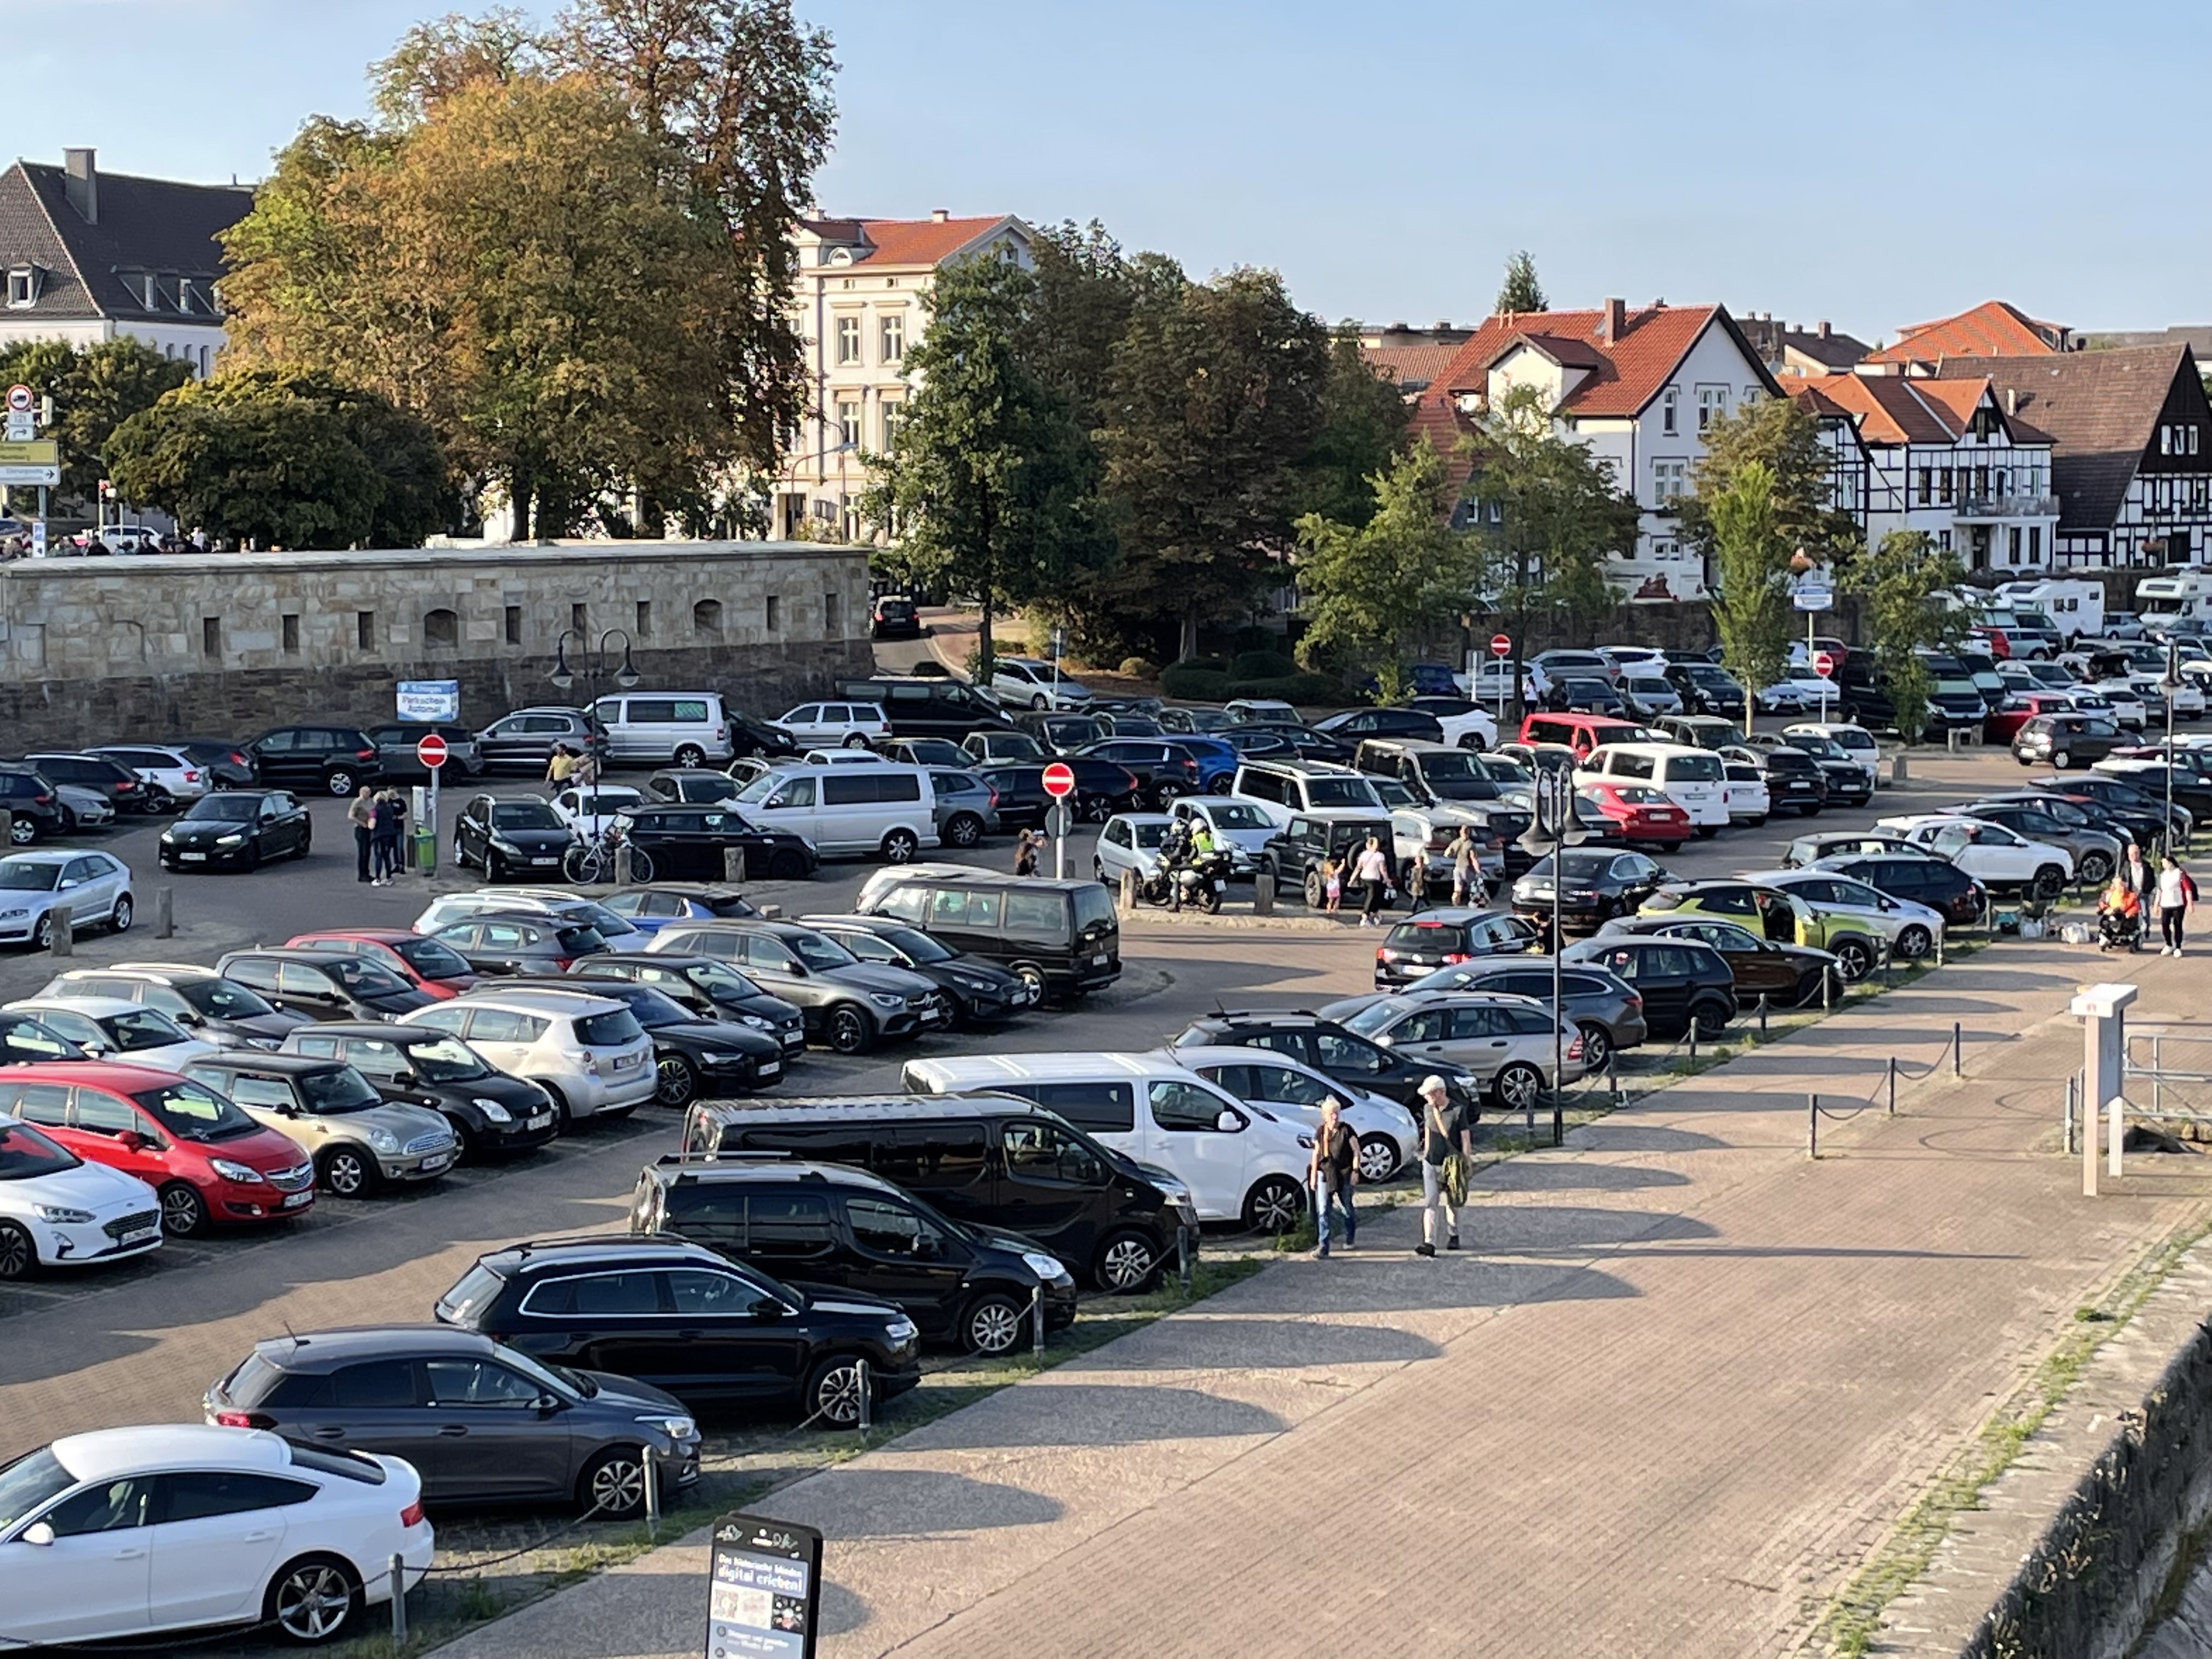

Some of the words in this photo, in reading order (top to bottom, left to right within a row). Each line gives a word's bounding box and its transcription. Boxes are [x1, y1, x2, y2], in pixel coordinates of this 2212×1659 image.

[402, 696, 446, 704] Parkschein
[408, 705, 442, 713] Automat
[718, 1564, 754, 1582] digital
[756, 1573, 803, 1592] erleben!
